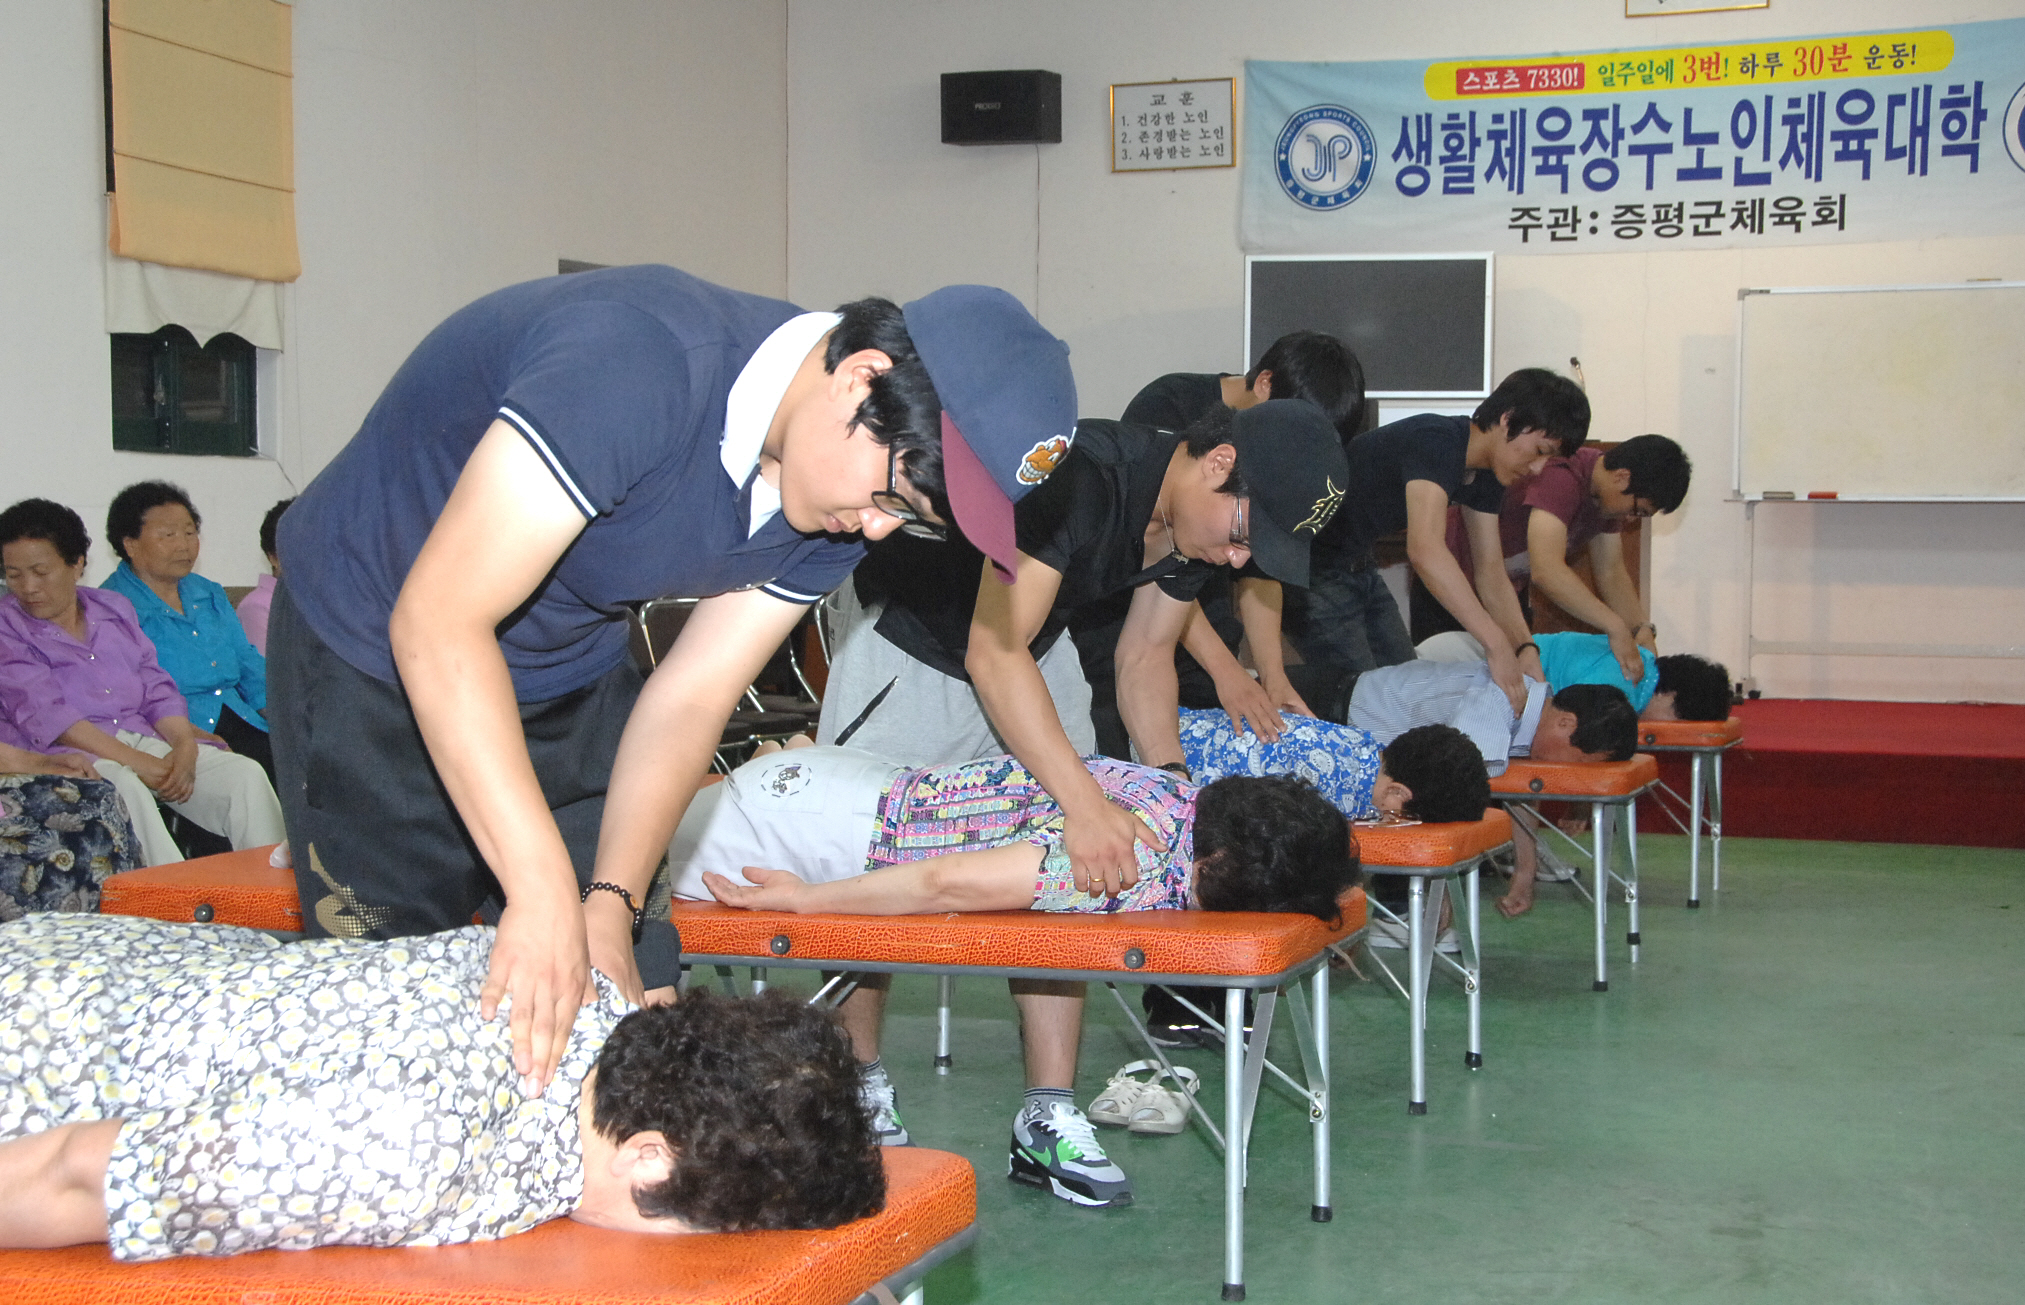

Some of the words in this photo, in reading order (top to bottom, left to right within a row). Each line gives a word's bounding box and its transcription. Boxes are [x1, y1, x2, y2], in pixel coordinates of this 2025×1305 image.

[1463, 69, 1520, 90] 스포츠
[1527, 67, 1579, 89] 7330!
[1598, 58, 1675, 87] 일주일에
[1683, 51, 1729, 84] 3번!
[1739, 52, 1784, 79] 하루
[1793, 42, 1852, 77] 30분
[1864, 43, 1917, 70] 운동!
[1121, 115, 1130, 126] 1.
[1137, 112, 1175, 126] 건강한
[1183, 110, 1208, 123] 노인
[1121, 132, 1131, 143] 2.
[1138, 128, 1191, 143] 존경받는
[1199, 126, 1224, 140] 노인
[1391, 81, 1988, 197] 생활체육장수노인체육대학
[1121, 149, 1131, 160] 3.
[1139, 145, 1191, 160] 사랑받는
[1199, 143, 1224, 156] 노인
[1611, 194, 1847, 239] 증평군체육회
